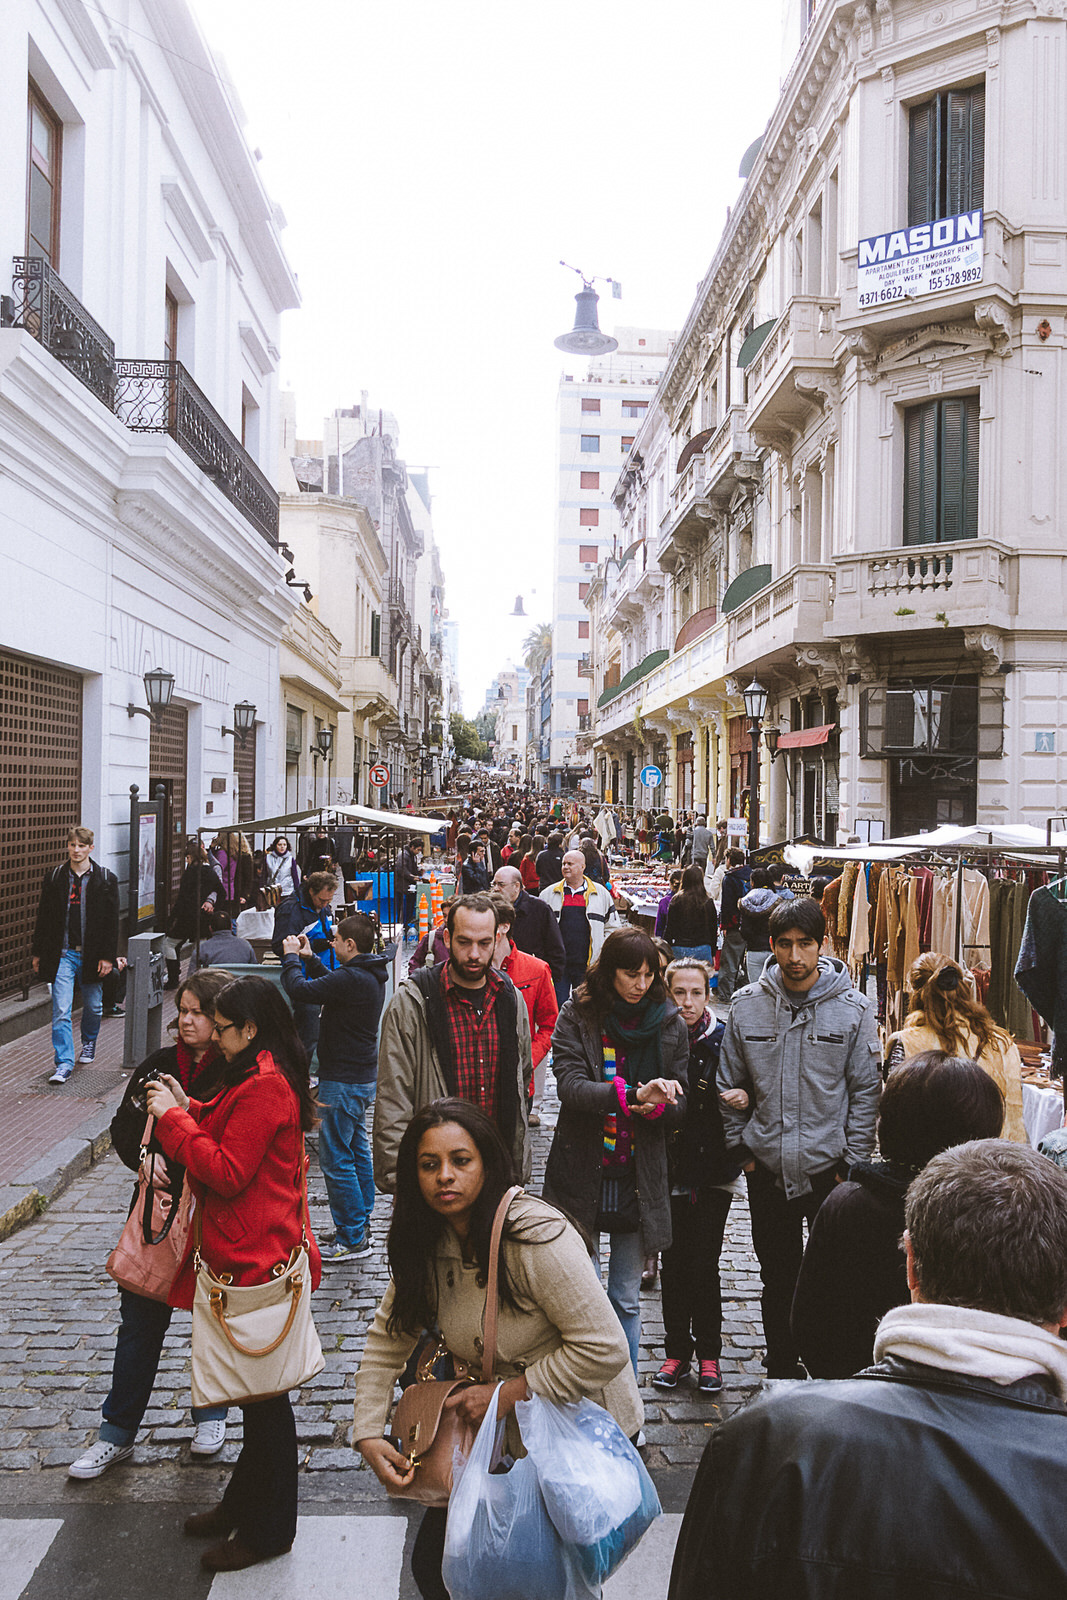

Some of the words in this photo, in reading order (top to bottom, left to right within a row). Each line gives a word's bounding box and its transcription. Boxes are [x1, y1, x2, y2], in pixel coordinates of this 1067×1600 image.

[859, 211, 981, 267] MASON
[865, 260, 904, 276] APARTAMENT
[906, 256, 920, 266] FOR
[923, 248, 956, 263] TEMPRARY
[957, 243, 974, 254] RENT
[918, 255, 961, 271] TEMPORARIOS
[884, 279, 895, 287] DAY
[903, 272, 923, 282] WEEK
[930, 265, 953, 276] MONTH
[375, 769, 384, 782] E
